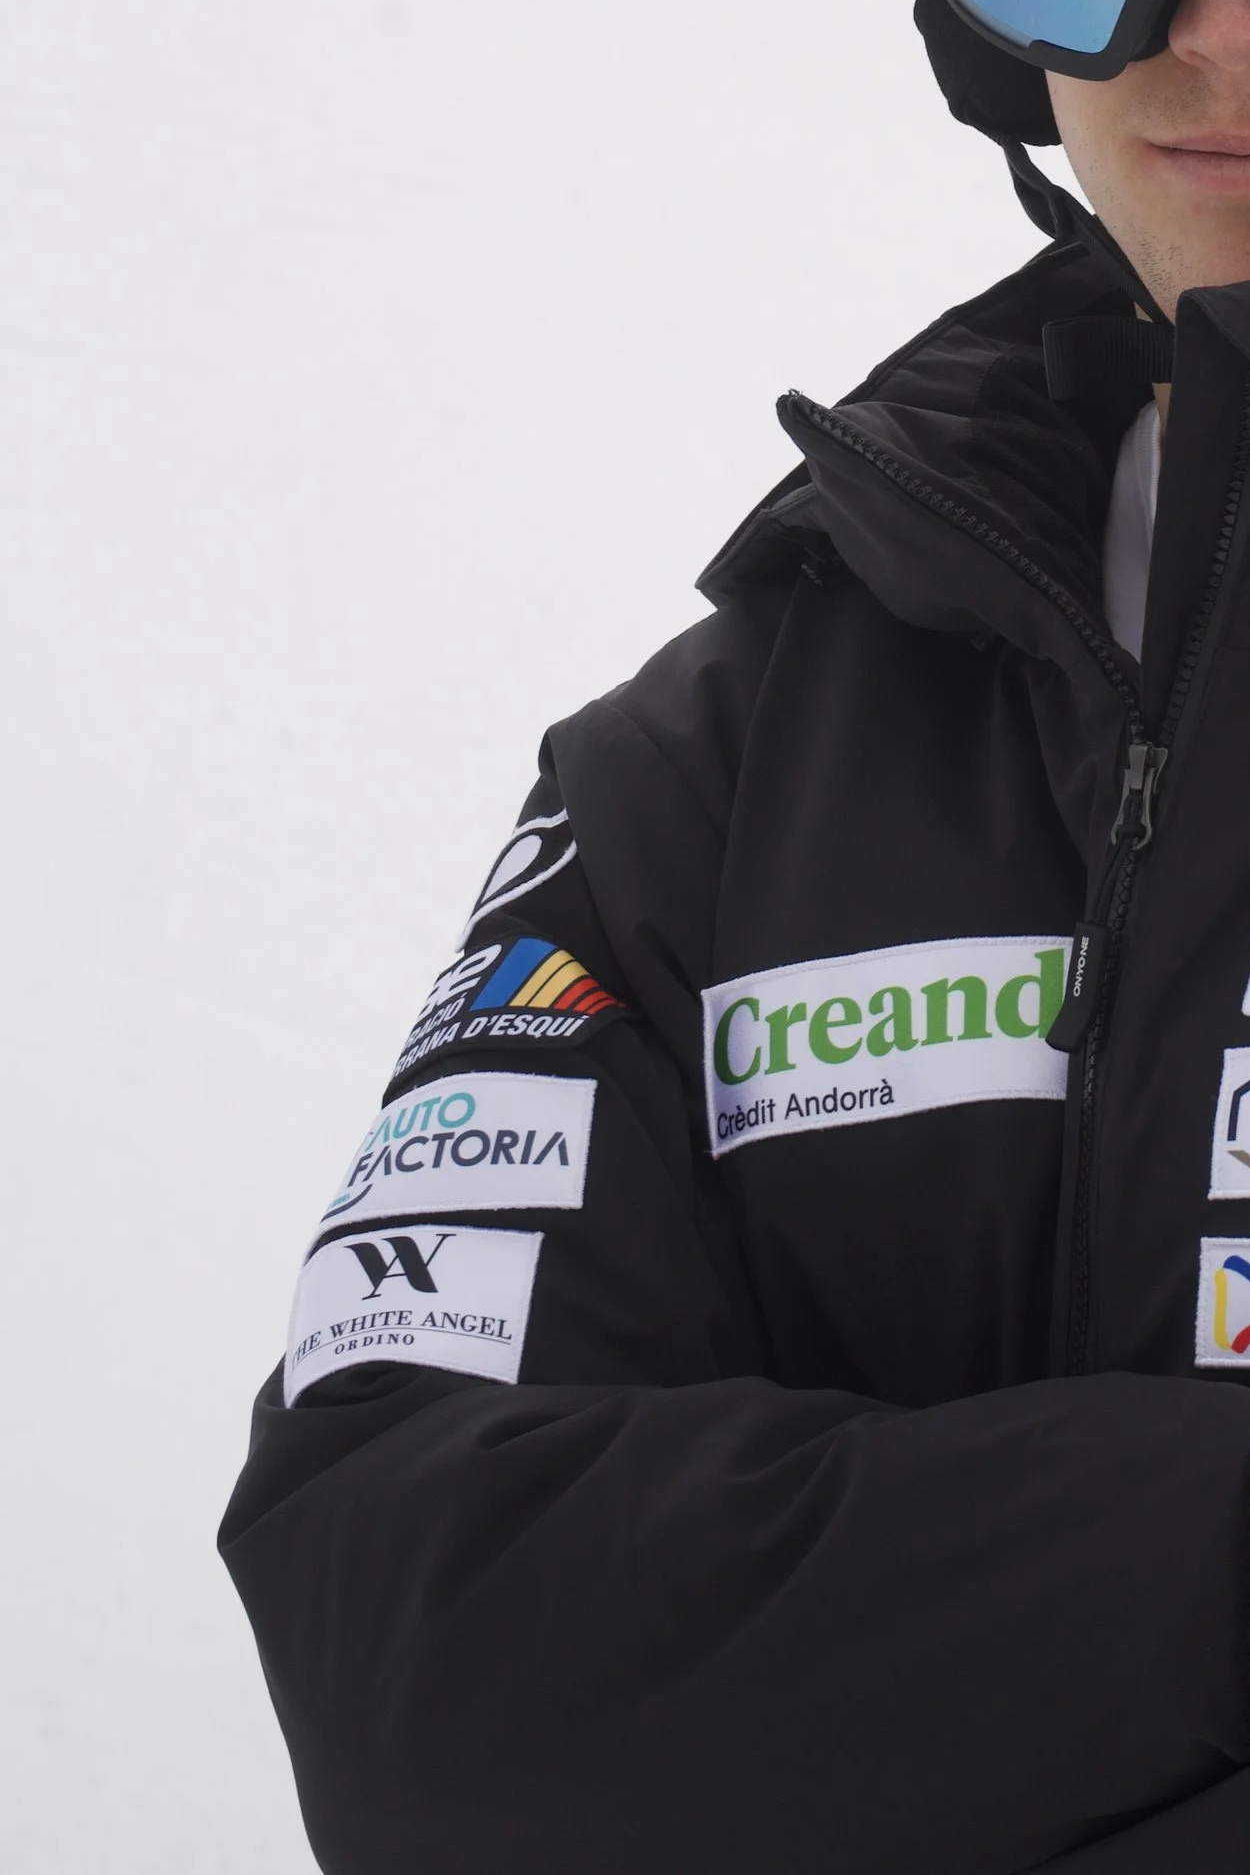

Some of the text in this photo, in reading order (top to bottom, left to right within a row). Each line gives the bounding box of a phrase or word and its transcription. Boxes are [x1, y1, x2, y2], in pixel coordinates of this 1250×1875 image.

[713, 947, 1066, 1086] Creand
[717, 1079, 895, 1140] Crèdit Andorrà
[347, 1129, 569, 1188] FACTORIA
[330, 1310, 413, 1339] WHITE
[422, 1311, 513, 1340] ANGEL
[335, 1333, 416, 1355] ORDINO
